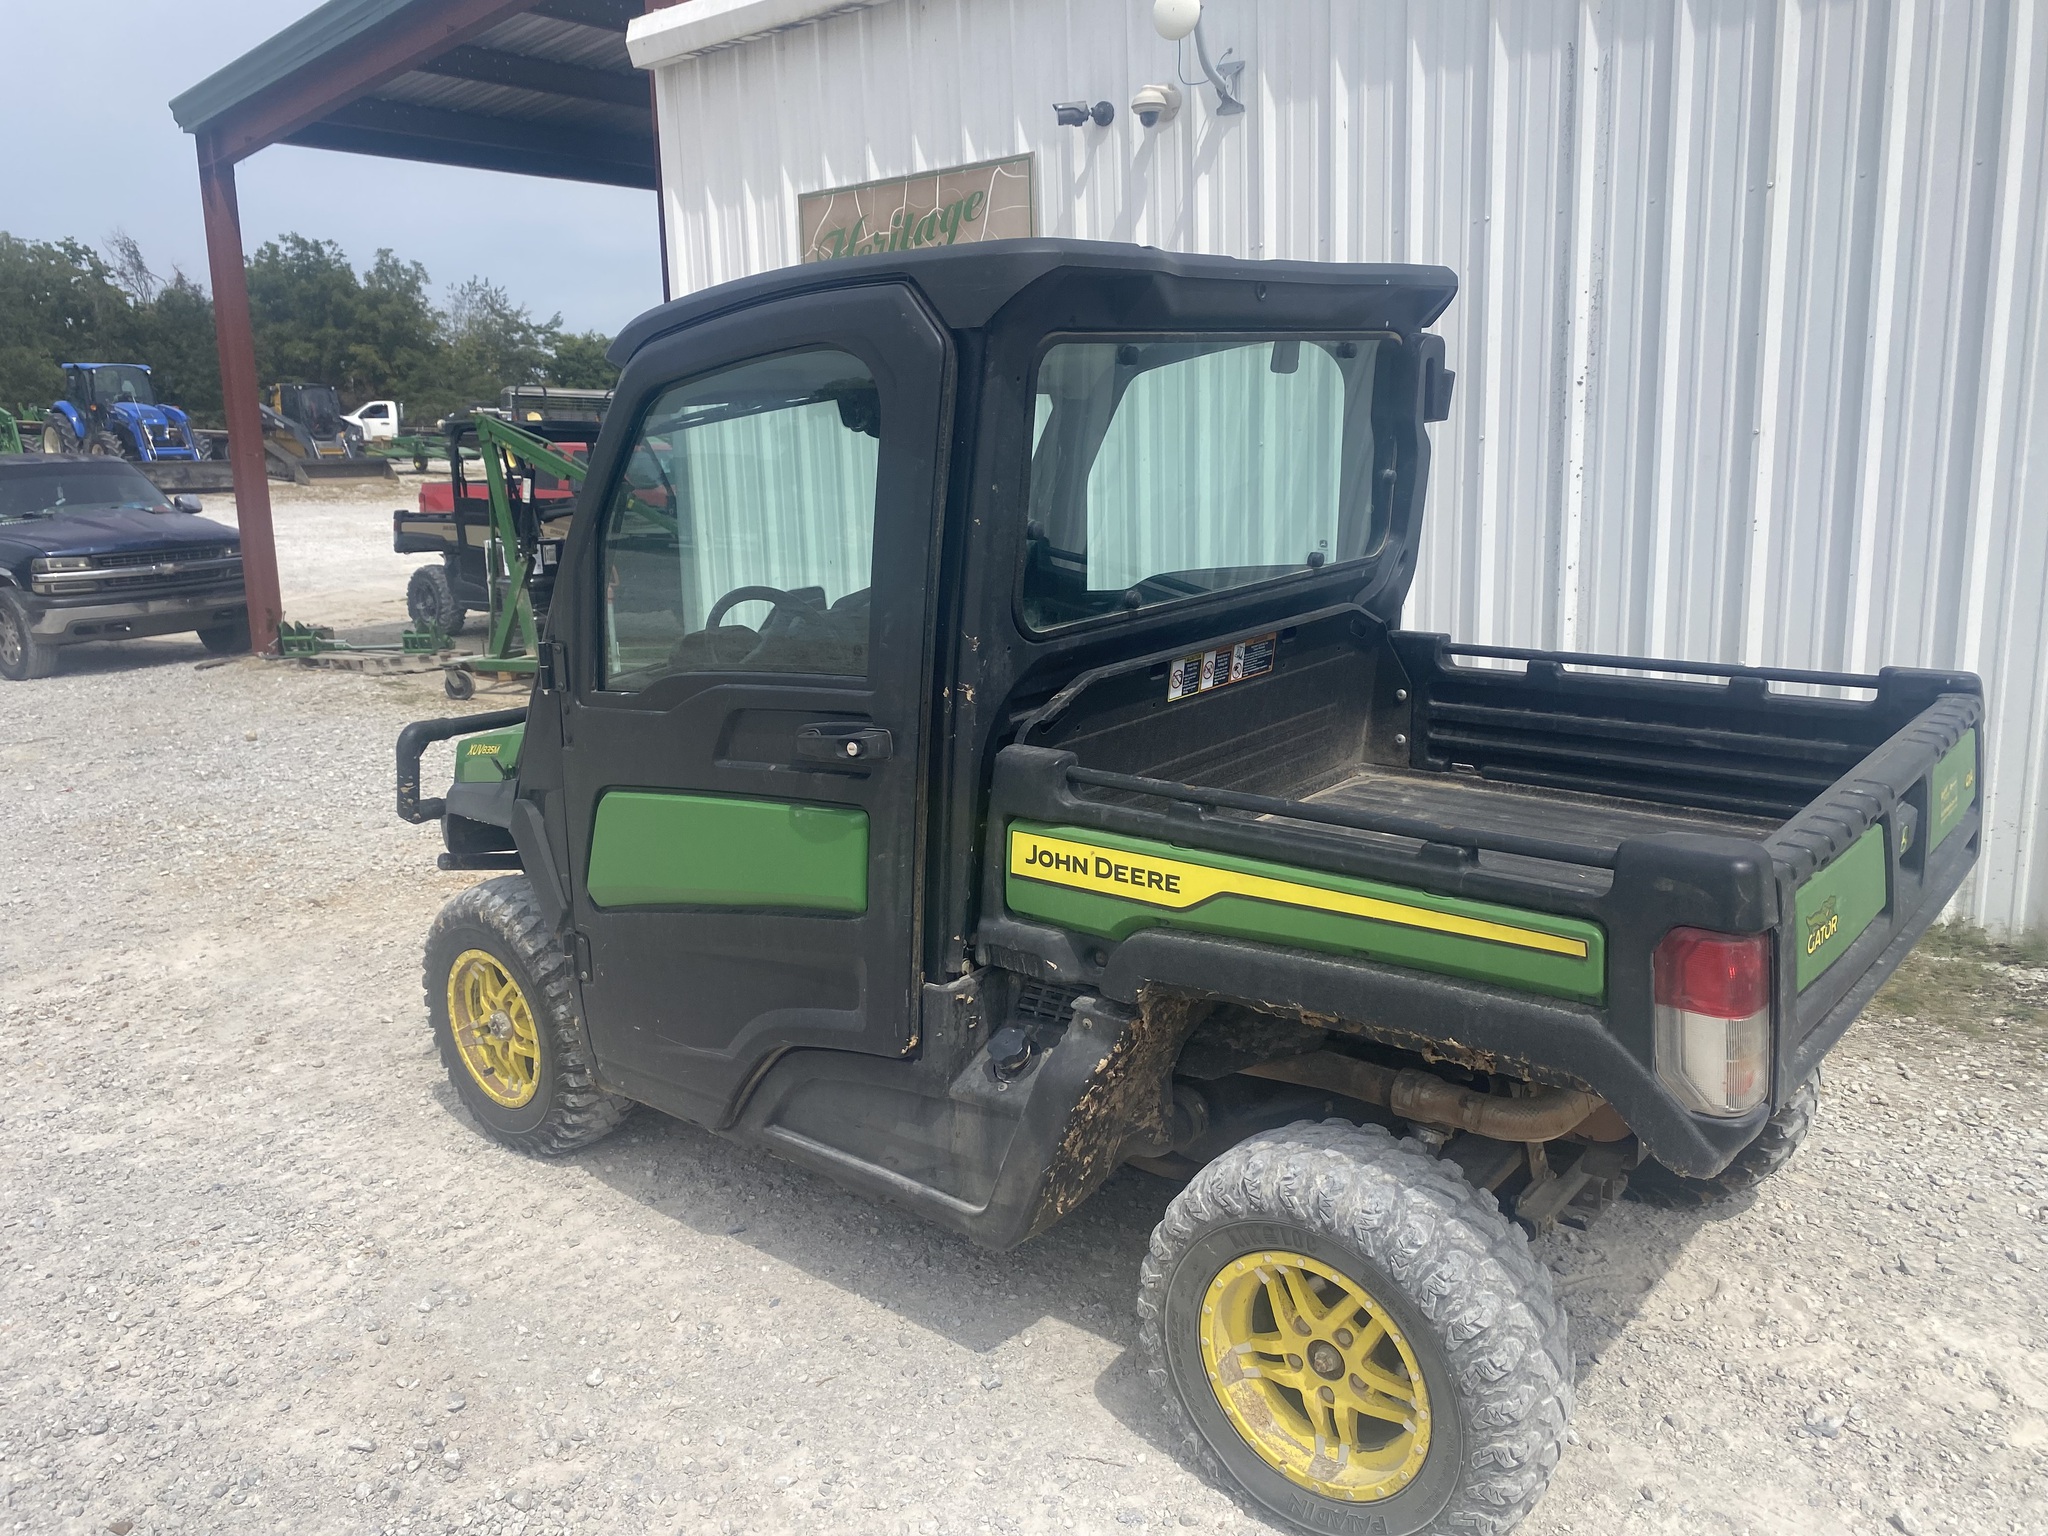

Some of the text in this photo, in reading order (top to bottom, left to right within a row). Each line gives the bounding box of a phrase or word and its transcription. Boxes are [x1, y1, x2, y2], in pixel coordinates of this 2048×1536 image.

[816, 190, 984, 262] Heritage
[1025, 844, 1181, 894] JOHN DEERE
[1807, 914, 1838, 954] GATOR
[1287, 1493, 1390, 1535] PALADIN
